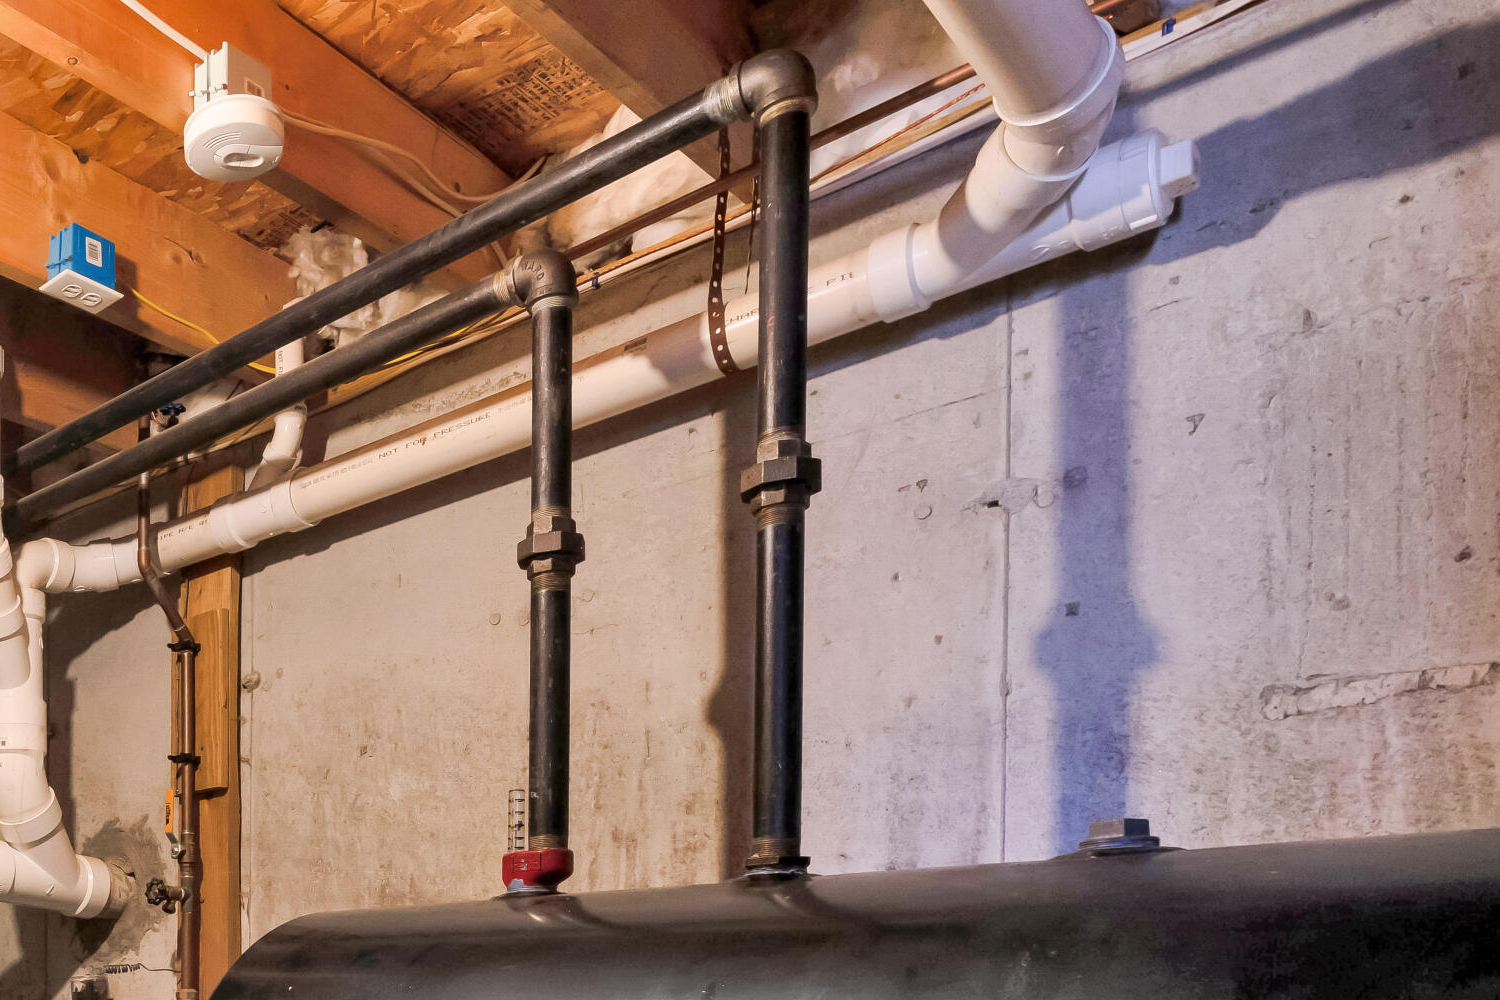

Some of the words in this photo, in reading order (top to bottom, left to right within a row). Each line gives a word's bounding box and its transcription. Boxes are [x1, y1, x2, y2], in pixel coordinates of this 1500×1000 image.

[378, 447, 399, 460] NOT
[405, 436, 427, 449] FOR
[432, 412, 492, 438] PRESSURE
